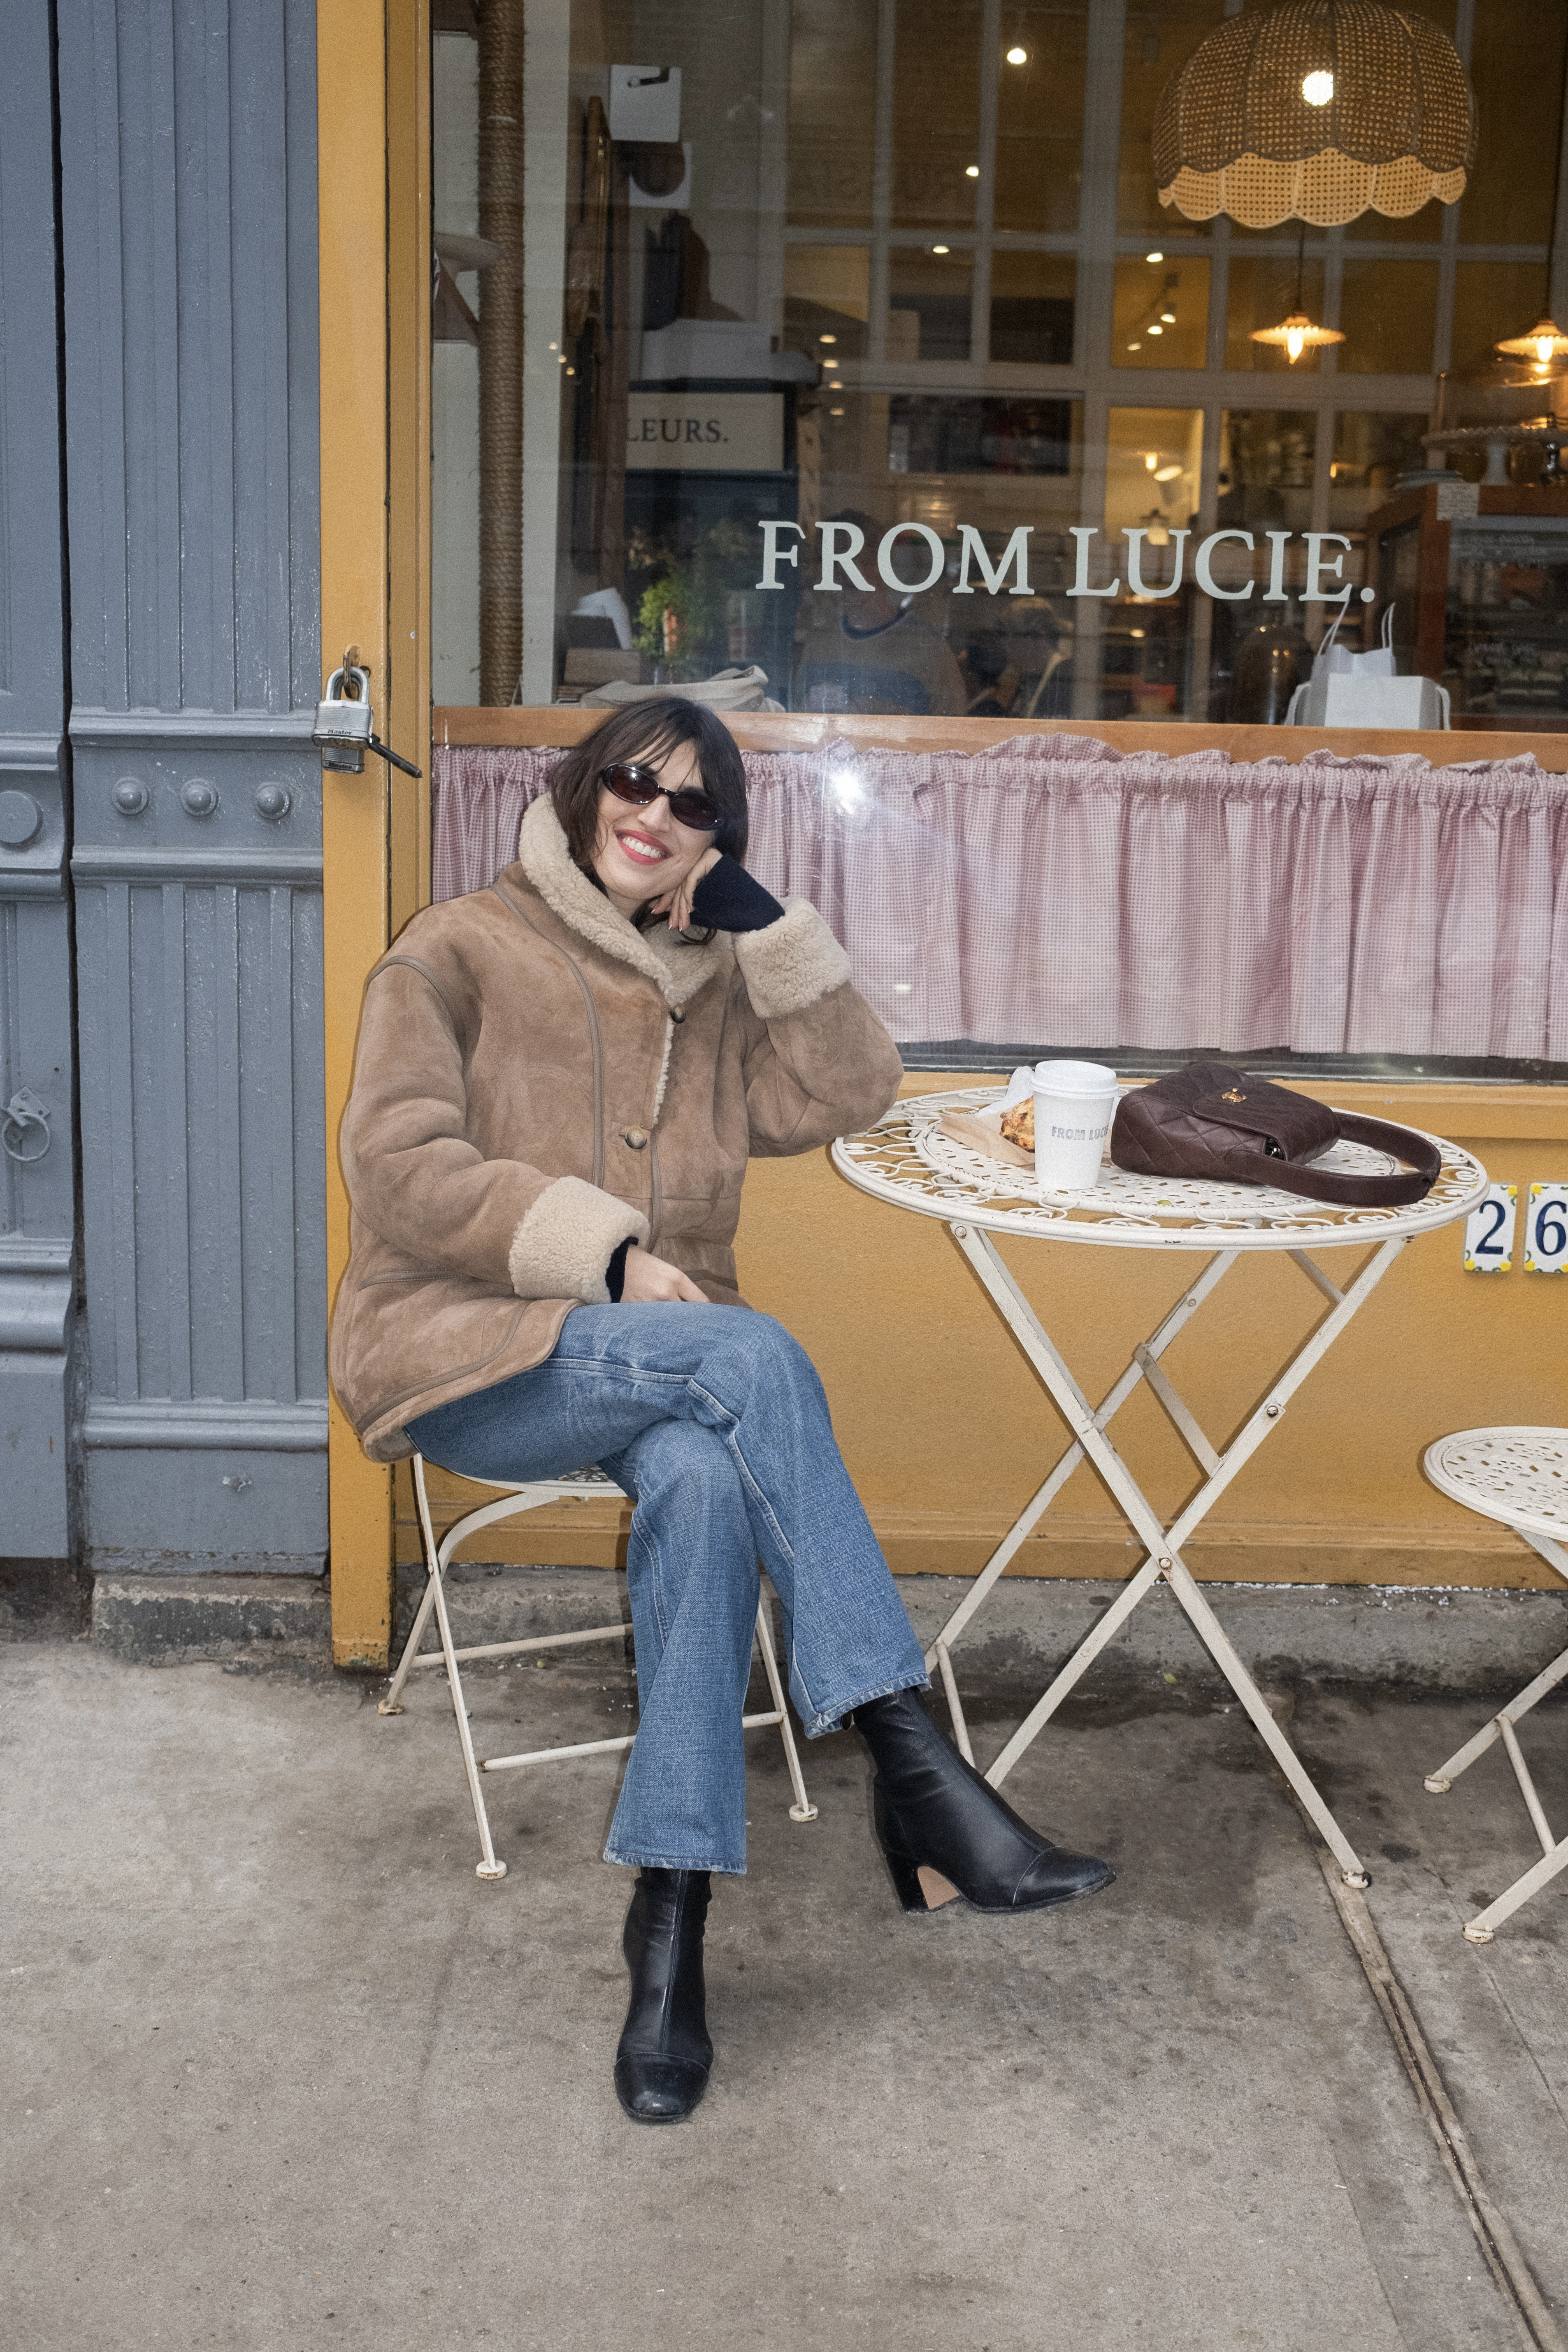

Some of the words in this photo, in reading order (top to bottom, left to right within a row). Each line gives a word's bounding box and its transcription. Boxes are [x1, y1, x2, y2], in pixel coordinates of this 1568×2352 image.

[755, 520, 1035, 595] FROM
[1066, 526, 1375, 603] LUCIE.
[1051, 1126, 1085, 1140] FROM
